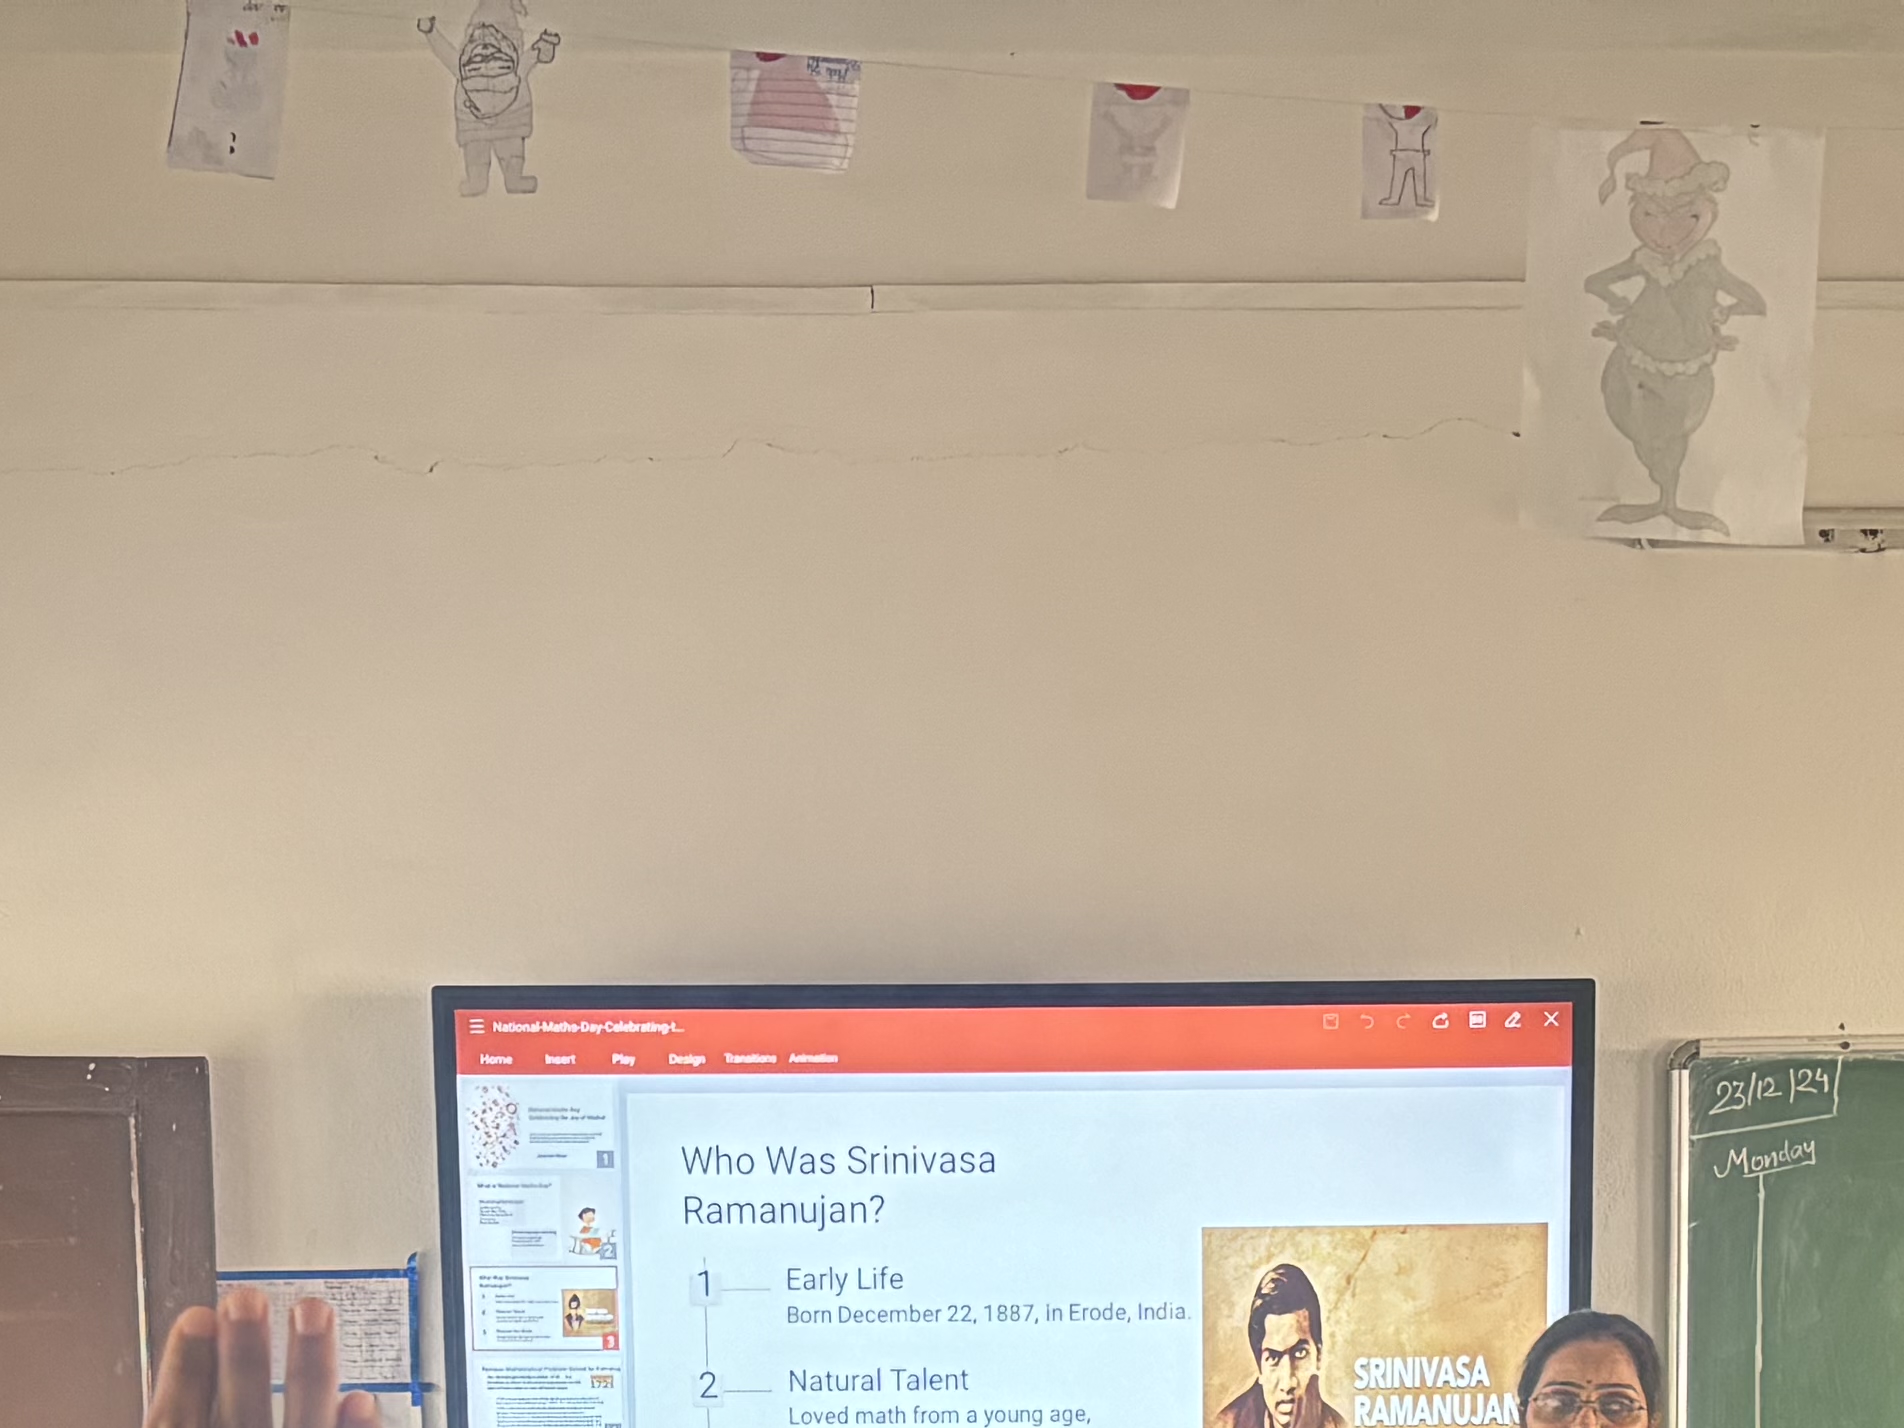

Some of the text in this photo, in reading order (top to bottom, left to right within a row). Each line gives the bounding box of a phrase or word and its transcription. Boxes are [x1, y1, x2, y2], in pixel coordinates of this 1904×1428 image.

[479, 1053, 839, 1067] Home Insert Play Design Transitions Animation
[682, 1145, 995, 1174] Who Was Srinivasa
[1713, 1138, 1815, 1178] Monday
[685, 1195, 884, 1231] Ramanujan?
[697, 1270, 711, 1297] 1
[788, 1266, 903, 1296] Early Life
[788, 1302, 1190, 1324] Born December 22, 1887, in Erode, India.
[698, 1371, 718, 1399] 2
[790, 1367, 968, 1391] Natural Talent
[1353, 1355, 1490, 1390] SRINIVASA
[790, 1406, 848, 1425] Loved
[856, 1406, 906, 1424] math
[914, 1406, 959, 1423] from
[967, 1410, 977, 1423] a
[1050, 1409, 1090, 1426] age,
